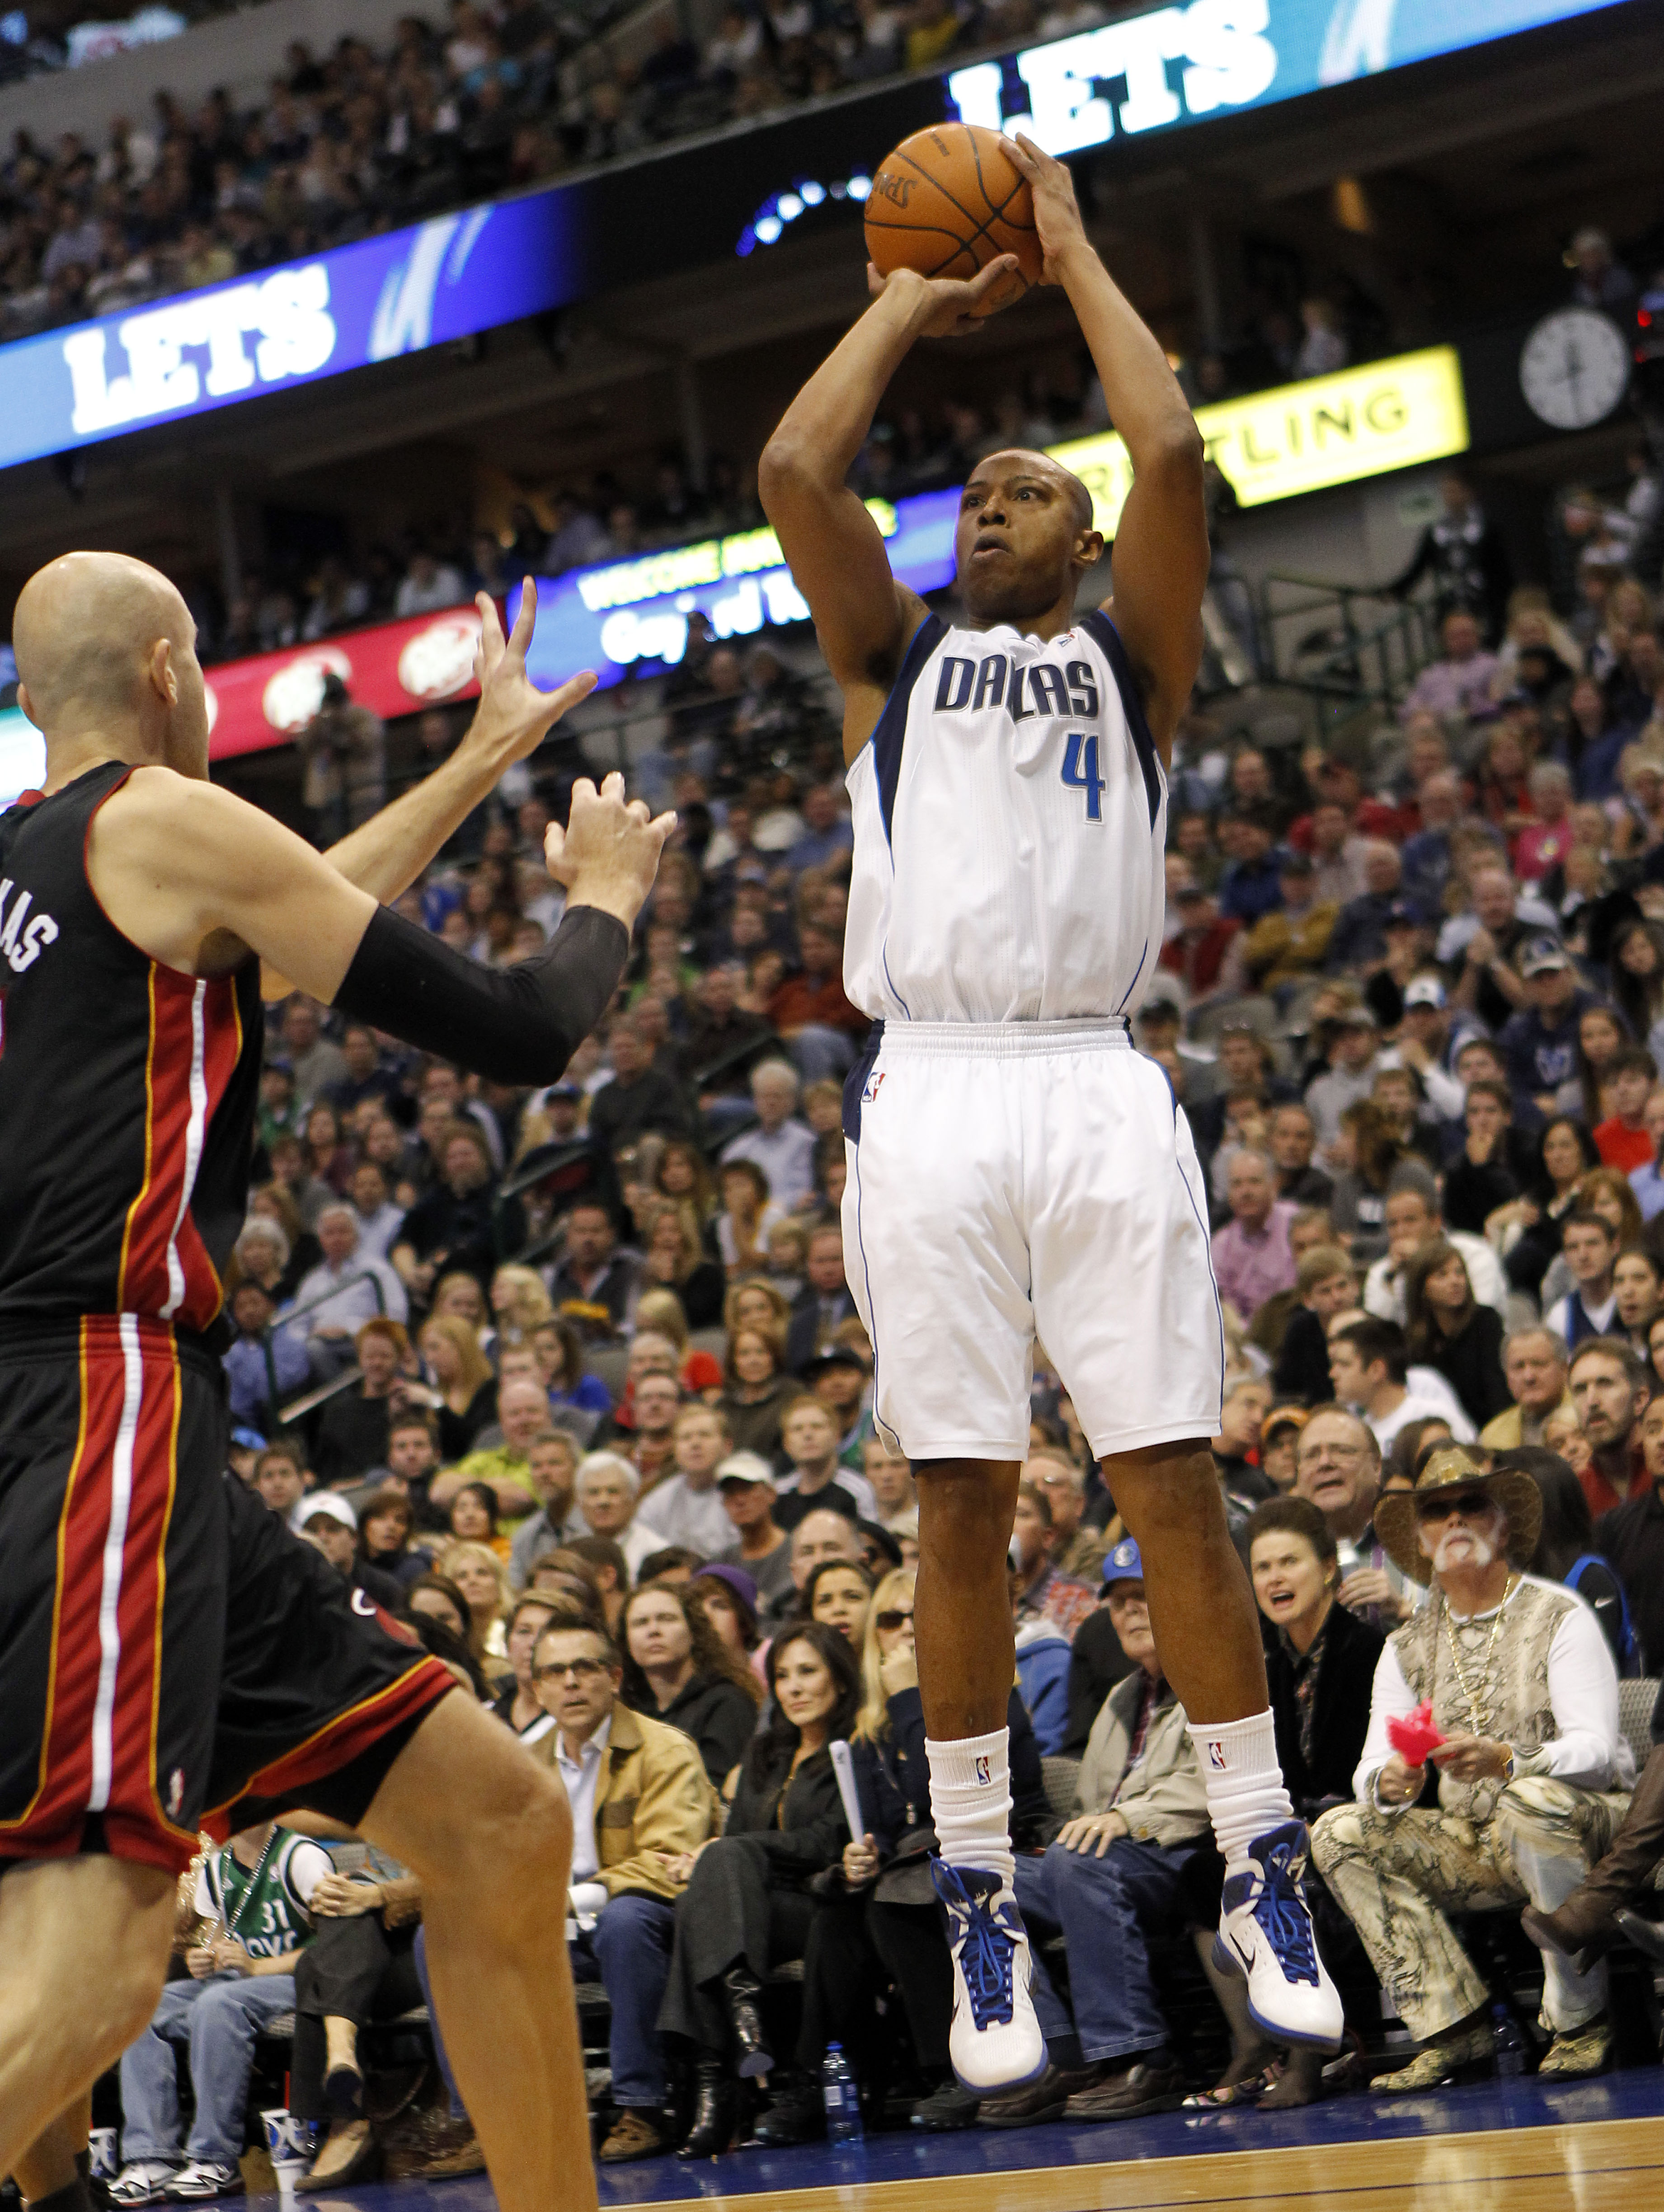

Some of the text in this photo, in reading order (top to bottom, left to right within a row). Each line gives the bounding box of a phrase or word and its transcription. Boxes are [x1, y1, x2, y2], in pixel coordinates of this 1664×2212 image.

[948, 0, 1278, 157] LETS
[62, 261, 338, 435] LETS
[1061, 731, 1107, 826] 4
[261, 1898, 291, 1934] 31
